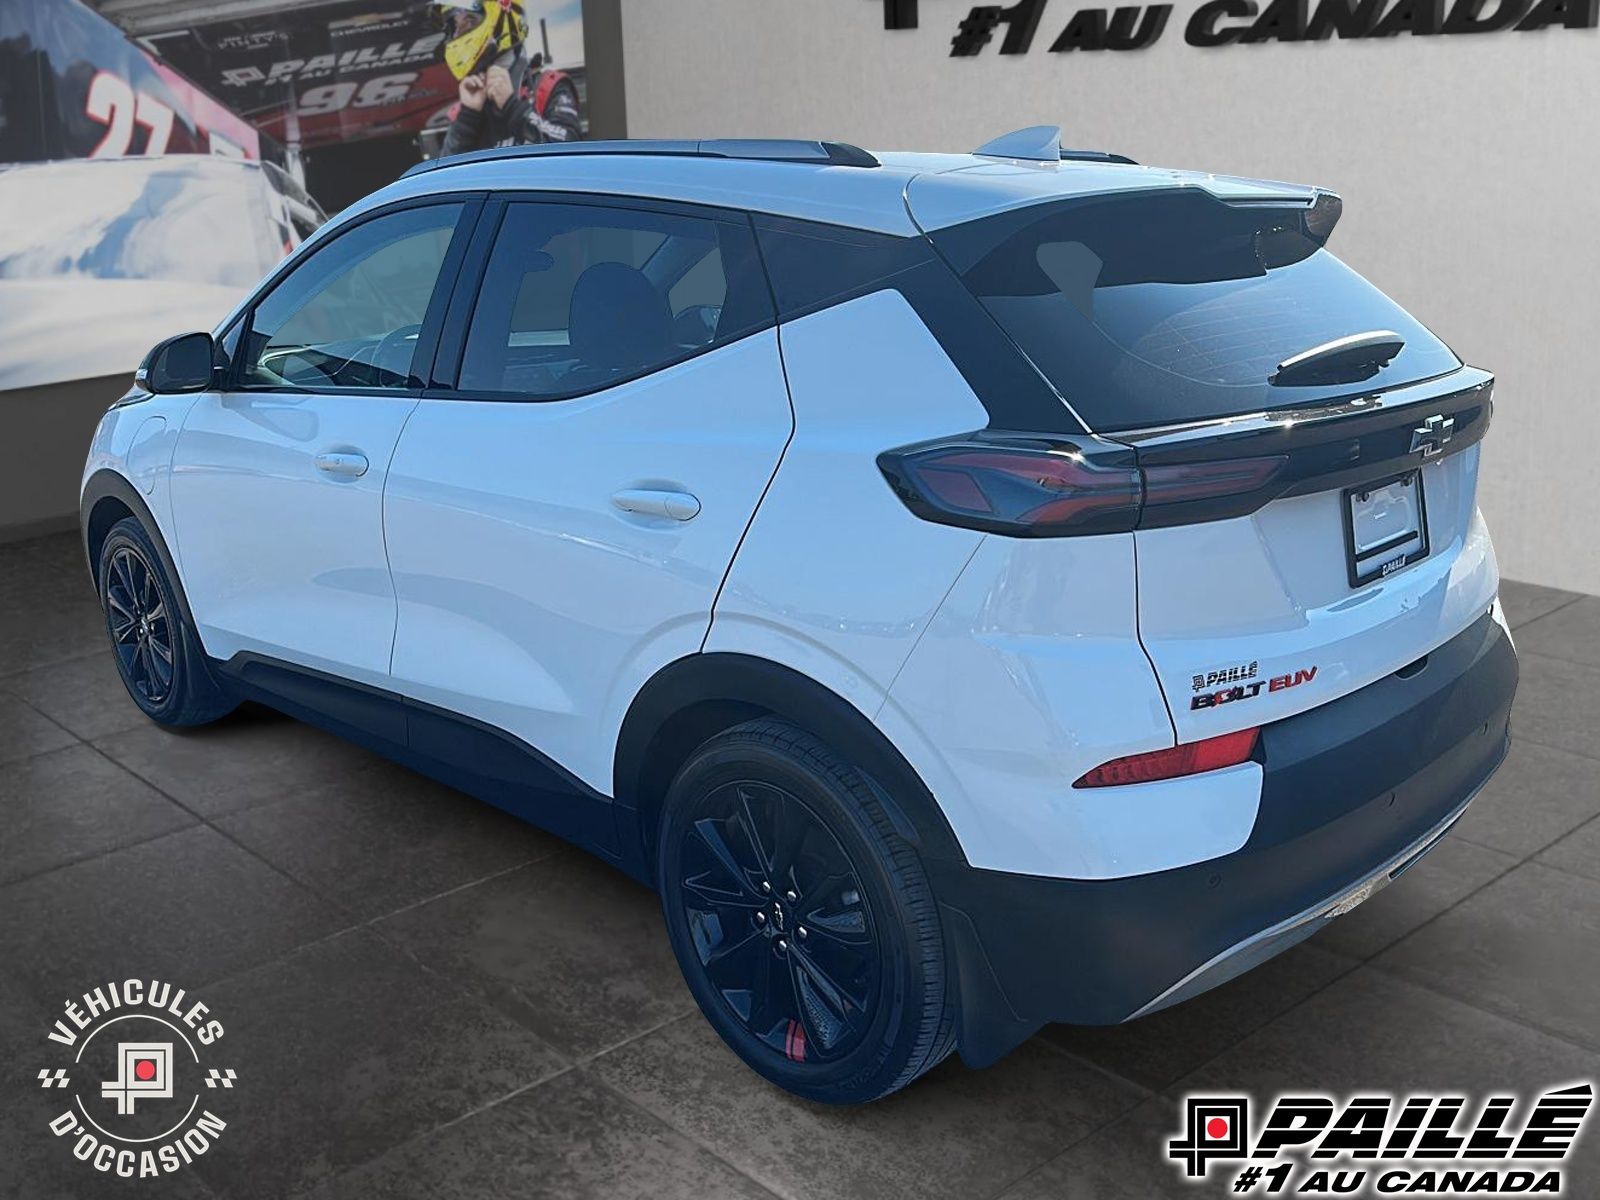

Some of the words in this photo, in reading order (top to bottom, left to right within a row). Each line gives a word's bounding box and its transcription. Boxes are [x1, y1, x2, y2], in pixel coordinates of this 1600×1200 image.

[330, 20, 409, 37] CHEVROLET
[949, 0, 1048, 57] #1
[1048, 4, 1174, 52] AU
[1184, 0, 1598, 47] CANADA
[300, 68, 332, 81] AU
[339, 52, 435, 74] CANADA
[297, 72, 419, 117] 96
[1190, 680, 1267, 710] BOLT
[1268, 665, 1318, 692] EUV
